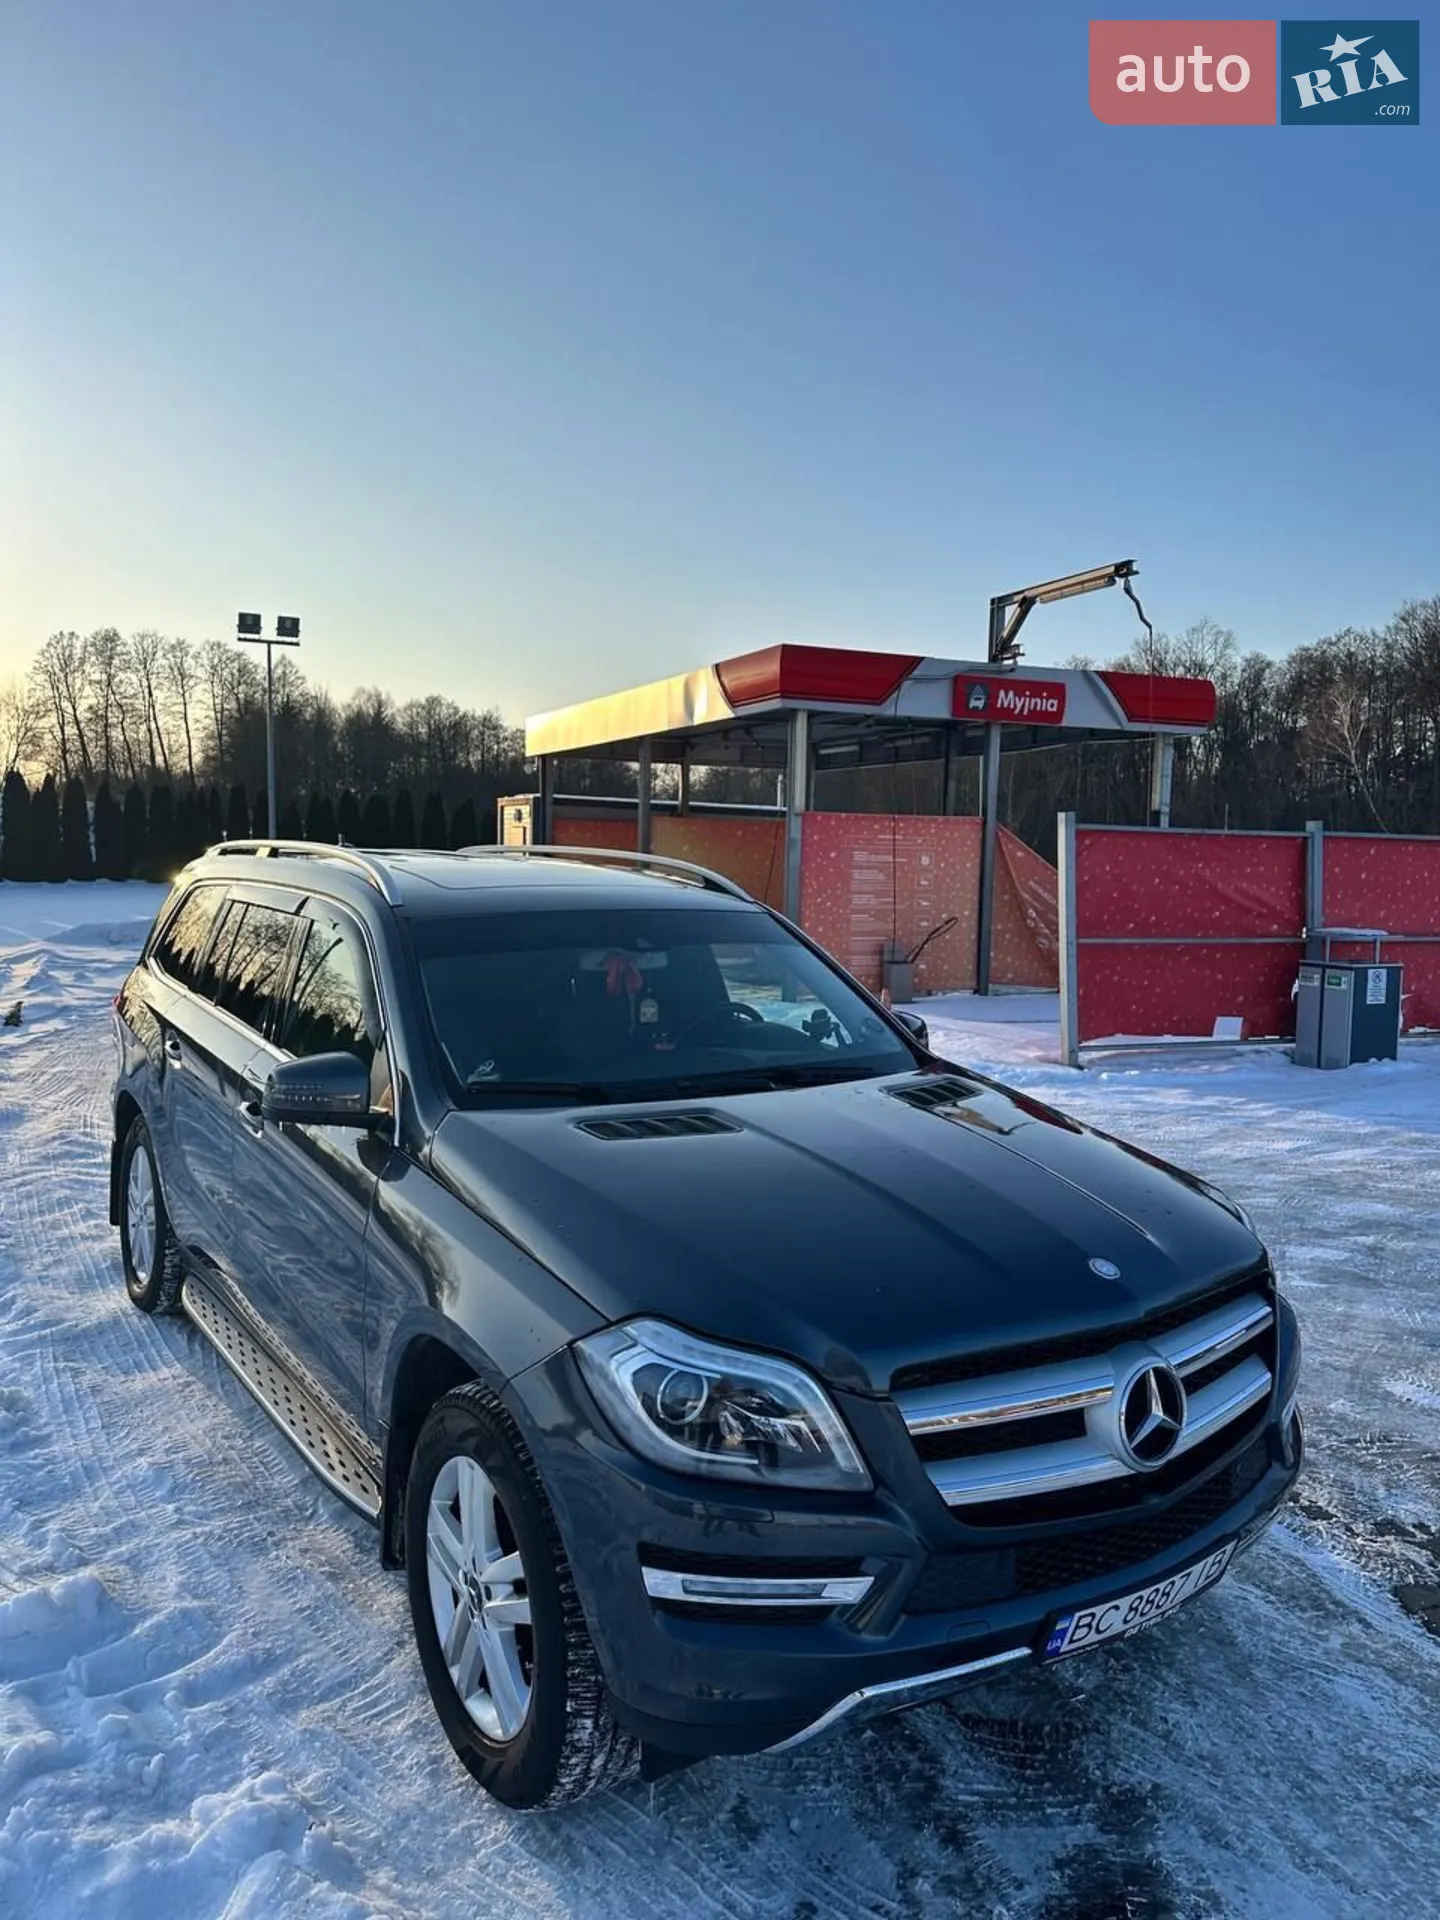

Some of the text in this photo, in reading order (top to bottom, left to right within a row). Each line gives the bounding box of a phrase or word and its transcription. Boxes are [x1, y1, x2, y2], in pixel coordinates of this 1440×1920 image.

[997, 689, 1058, 715] Myjnia
[1068, 1605, 1120, 1645] BC
[1123, 1571, 1194, 1625] 8887
